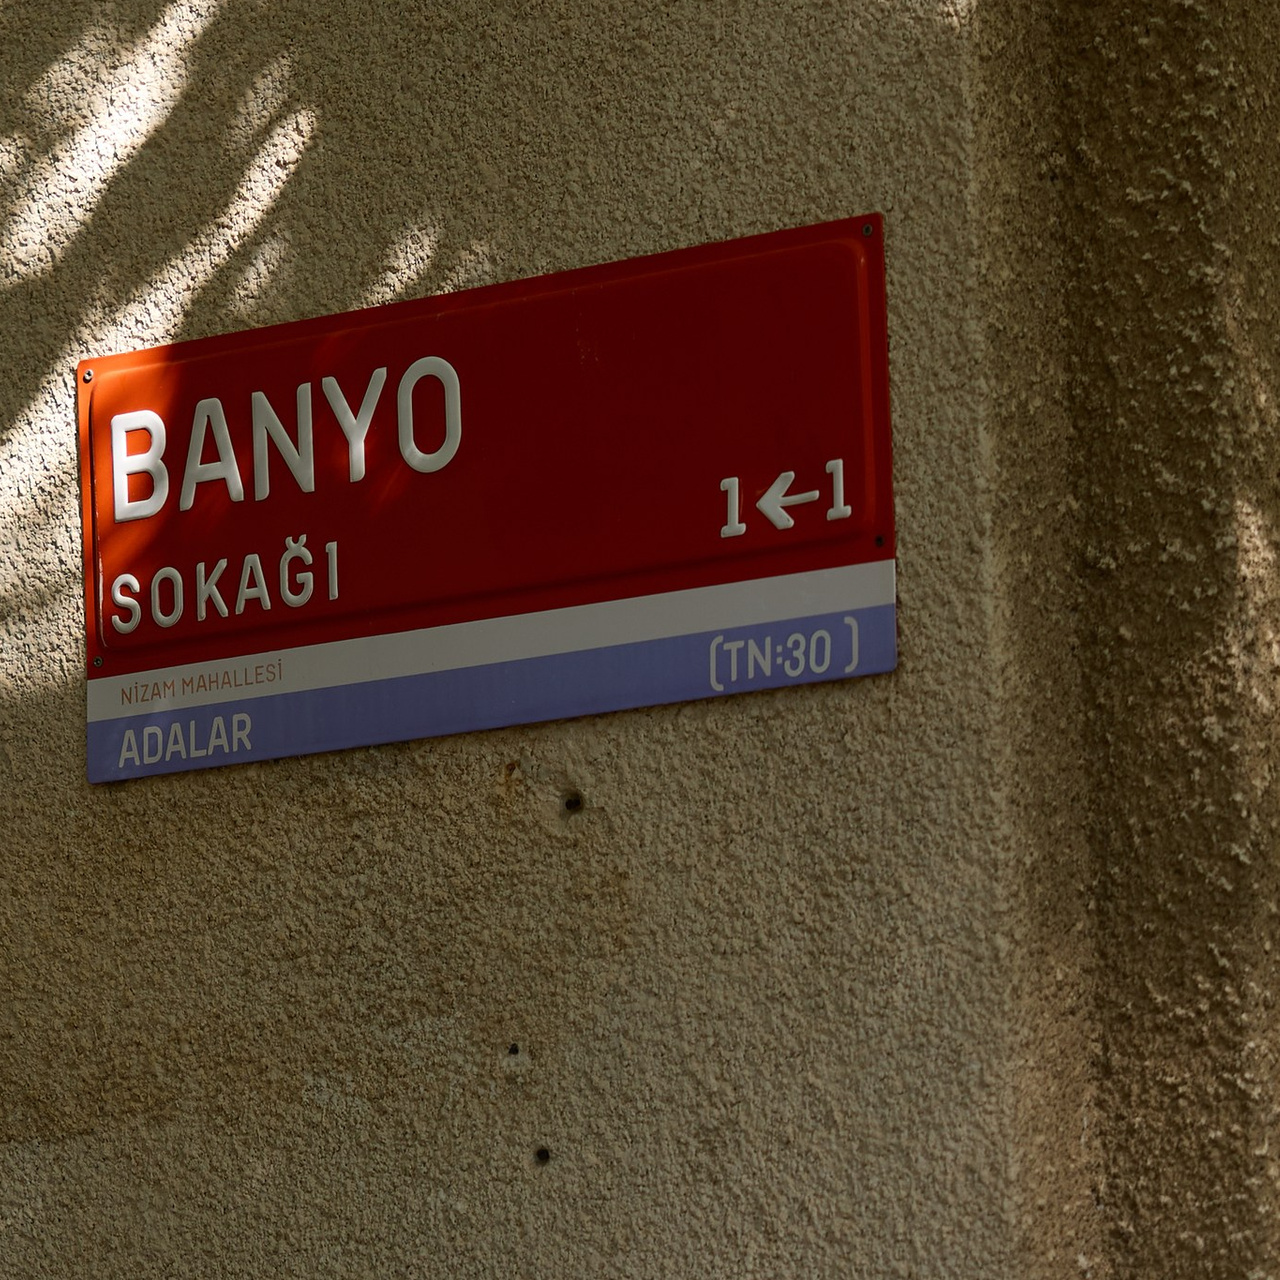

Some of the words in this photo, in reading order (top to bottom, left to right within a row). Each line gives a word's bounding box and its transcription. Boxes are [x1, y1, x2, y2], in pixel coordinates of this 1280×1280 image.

[111, 356, 462, 522] BANYO
[720, 476, 747, 538] 1
[825, 458, 852, 521] 1
[111, 534, 338, 635] SOKAĞI
[120, 681, 176, 706] NİZAM
[181, 658, 283, 697] MAHALLESİ
[118, 712, 252, 769] ADALAR
